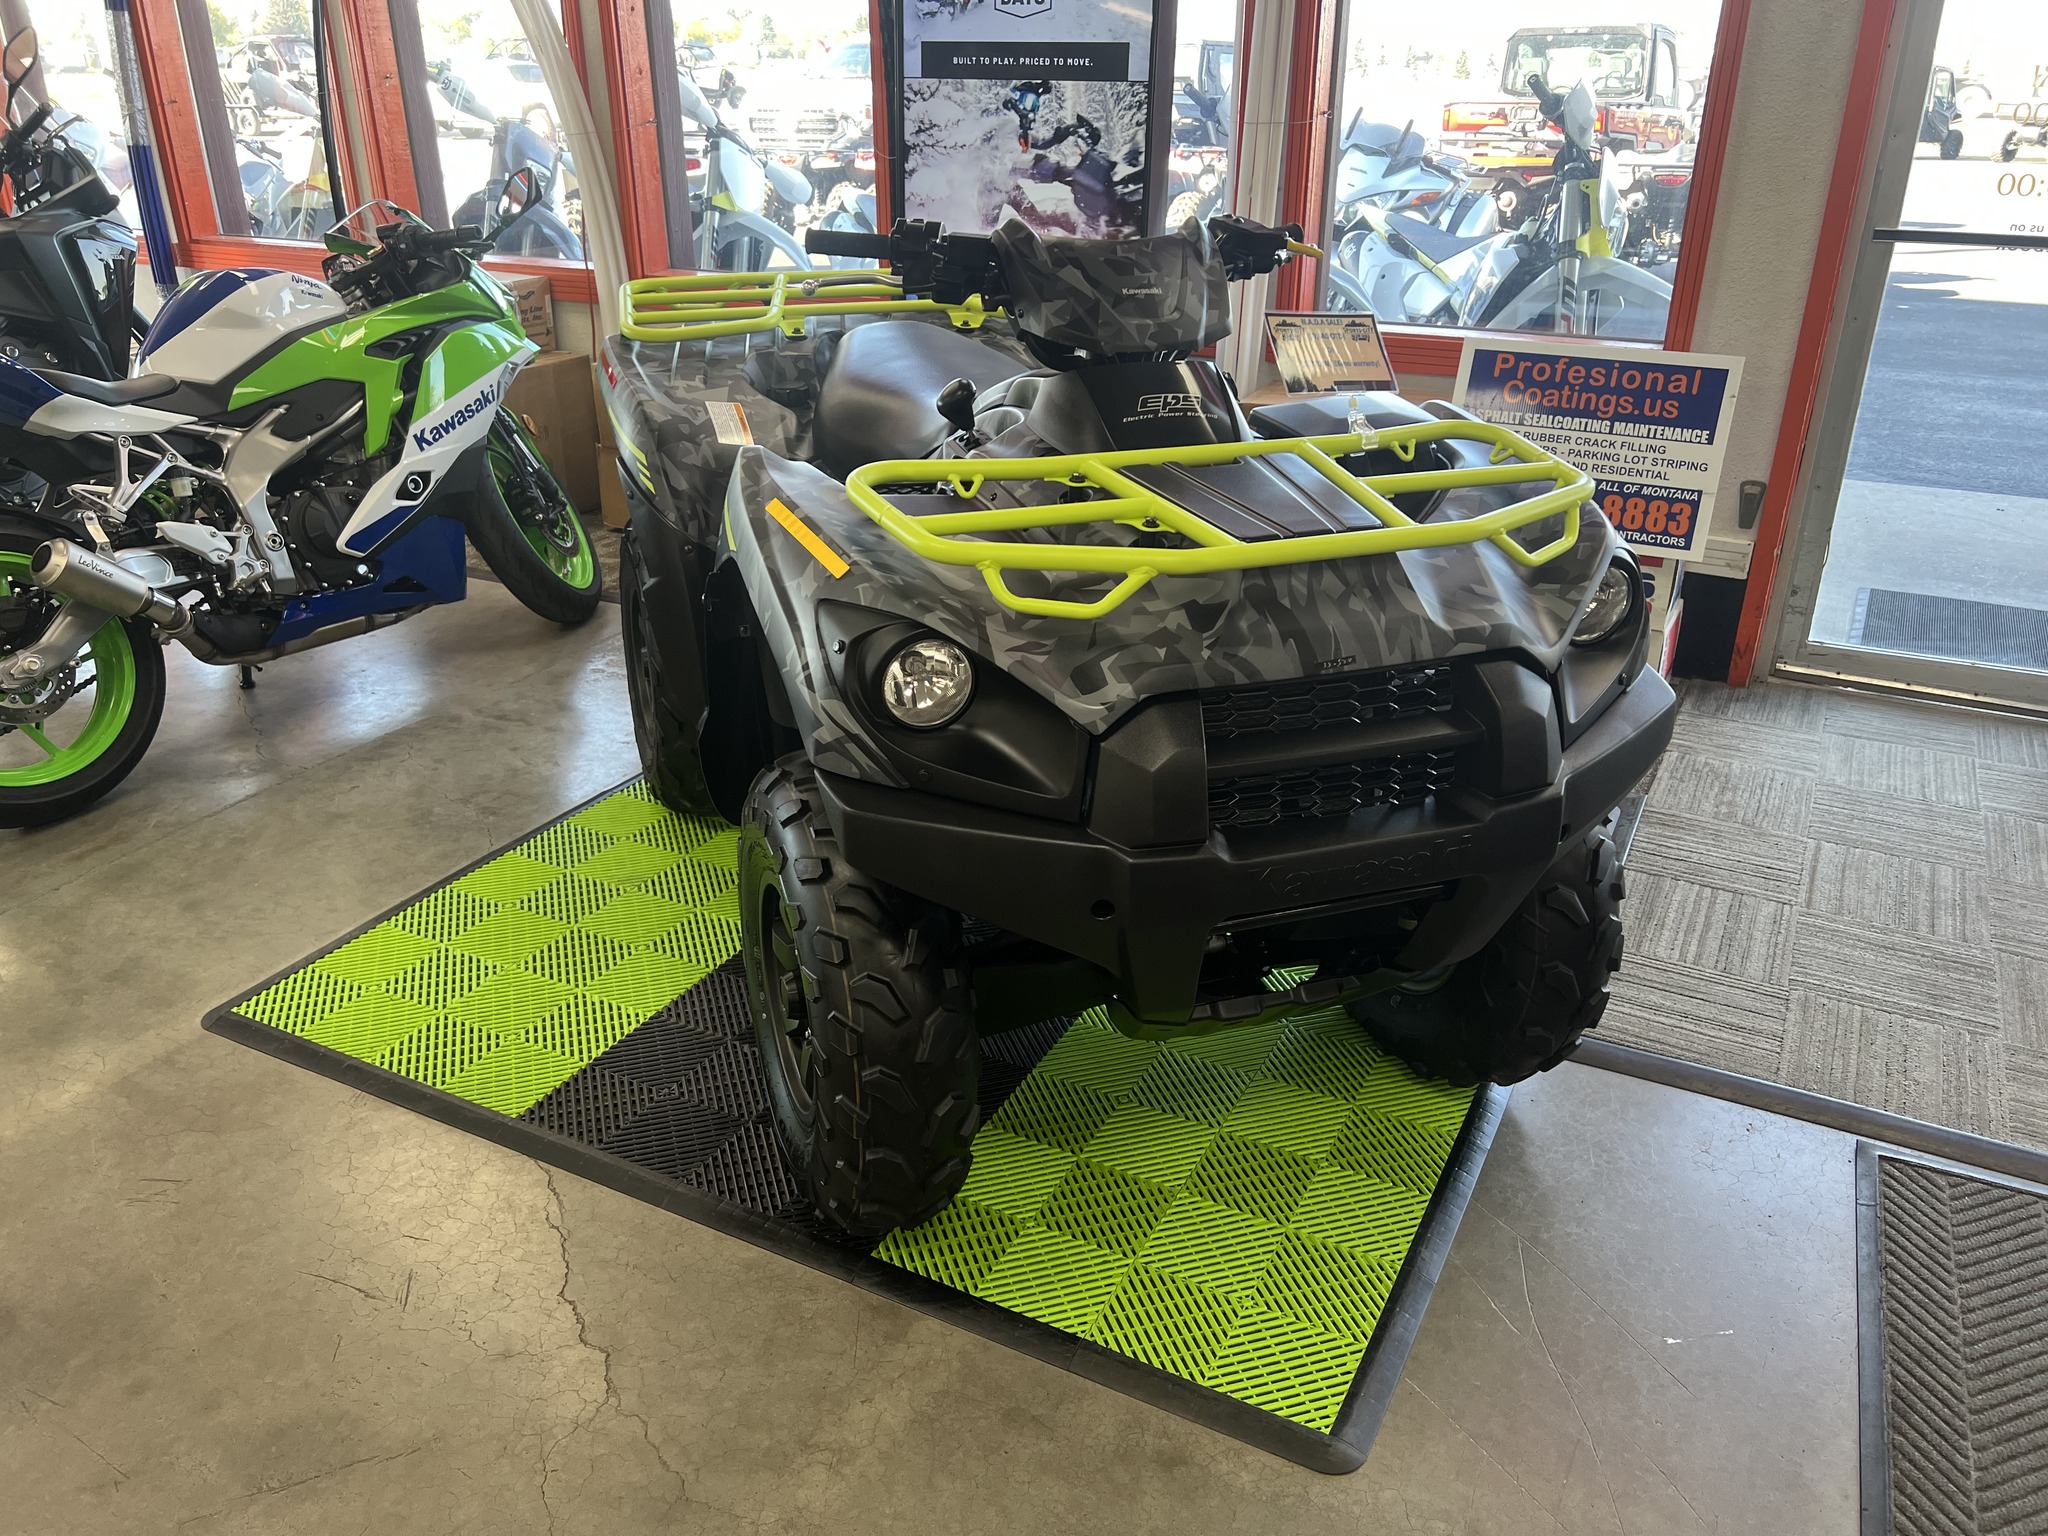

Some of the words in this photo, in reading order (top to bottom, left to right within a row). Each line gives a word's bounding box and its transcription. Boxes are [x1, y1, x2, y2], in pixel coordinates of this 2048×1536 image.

[953, 56, 977, 65] BUILT
[979, 57, 990, 65] TO
[993, 57, 1017, 65] PLAY.
[1019, 57, 1051, 66] PRICED
[1053, 57, 1064, 66] TO
[1067, 58, 1094, 66] MOVE.
[1121, 287, 1163, 296] Kawasaki
[1493, 353, 1702, 395] Profesional
[1138, 393, 1202, 413] EPS
[1503, 379, 1680, 419] Coatings.us
[412, 384, 496, 452] Kawasaki
[1122, 410, 1155, 423] Electric
[1186, 411, 1218, 420] Steering
[1468, 408, 1524, 426] ASPHALT
[1523, 412, 1610, 435] SEALCOATING
[1613, 421, 1710, 444] MAINTENANCE
[1524, 432, 1571, 445] RUBBER
[1575, 437, 1617, 450] CRACK
[1620, 441, 1667, 455] FILLING
[1568, 448, 1620, 463] PARKING
[1624, 454, 1648, 466] LOT
[1651, 457, 1709, 472] STRIPING
[1591, 463, 1670, 481] RESIDENTIAL
[1598, 481, 1620, 492] ALL
[1623, 484, 1641, 495] OF
[1641, 486, 1699, 501] MONTANA
[1603, 494, 1691, 536] 8883
[1618, 530, 1686, 547] NTRACTORS
[77, 554, 114, 578] LeoVince
